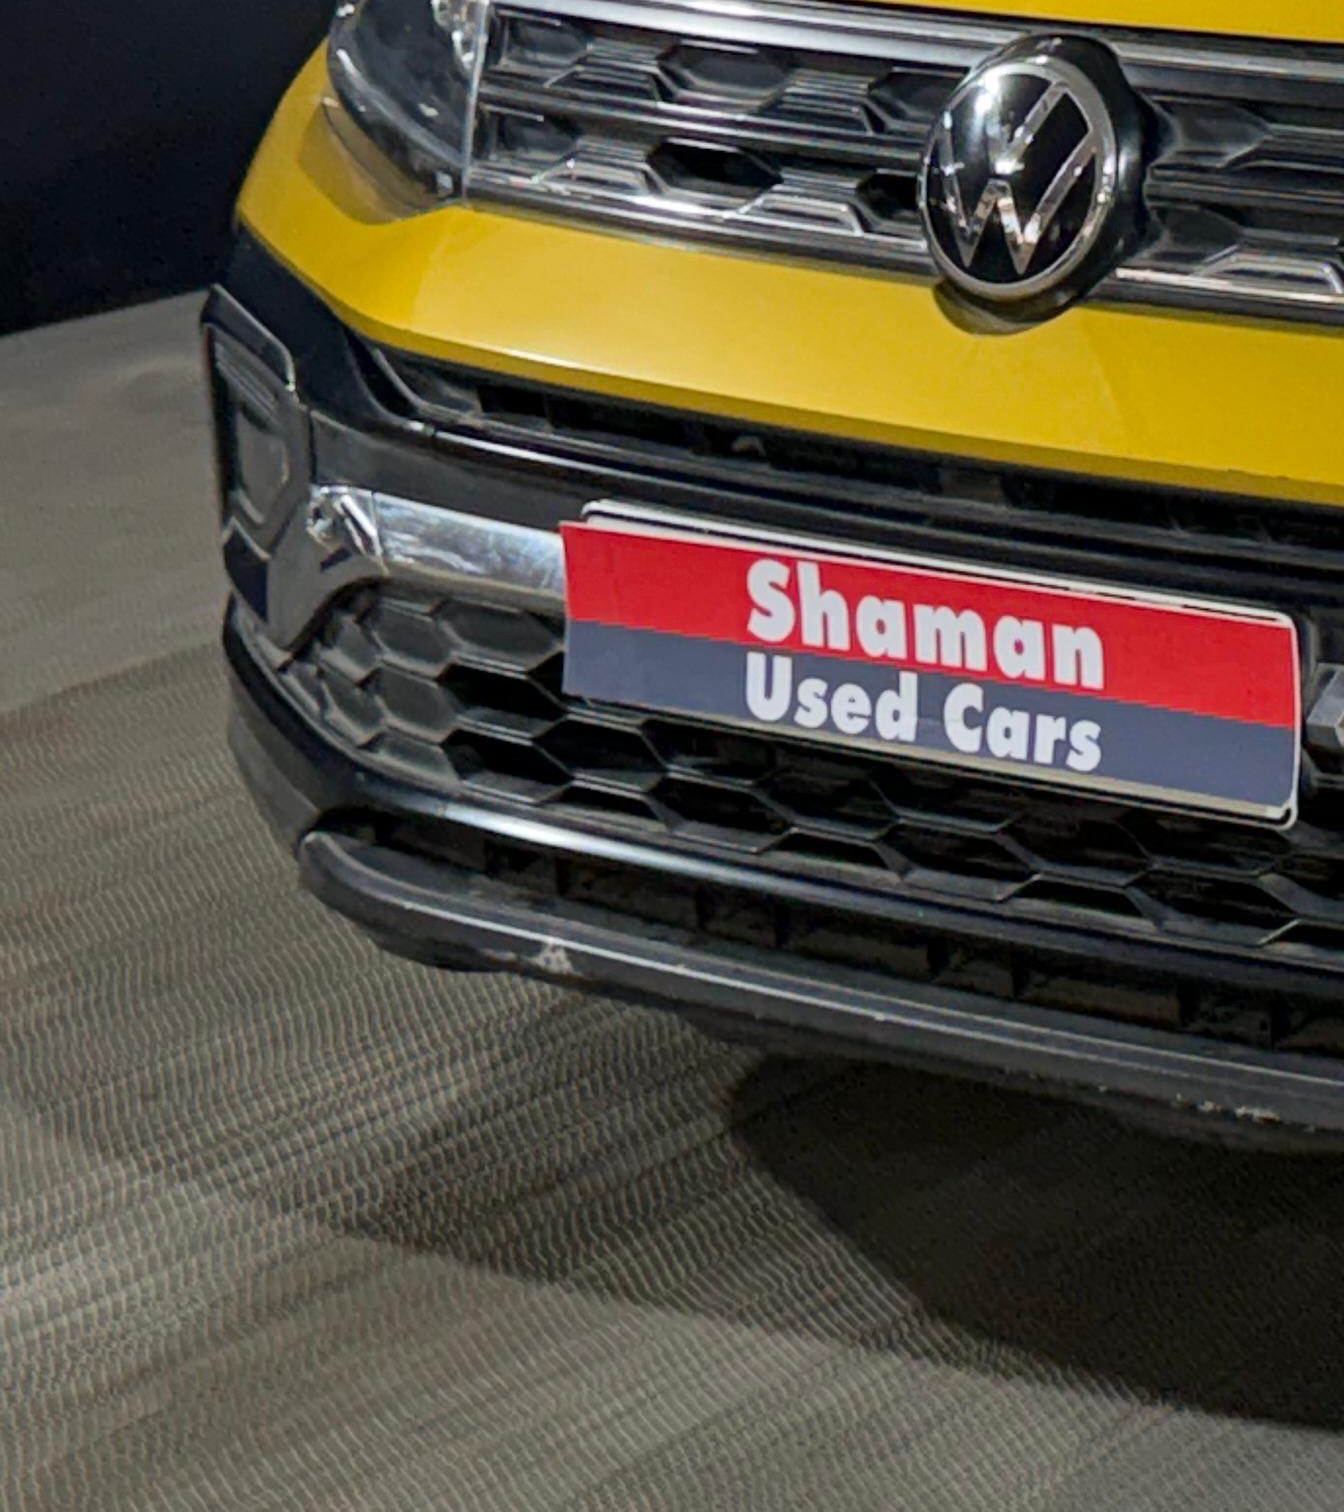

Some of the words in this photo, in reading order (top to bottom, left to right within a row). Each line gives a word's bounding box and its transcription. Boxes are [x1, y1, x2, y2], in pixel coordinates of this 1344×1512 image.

[746, 560, 1104, 691] Shaman
[746, 652, 918, 743] Used
[943, 683, 1102, 772] Cars
